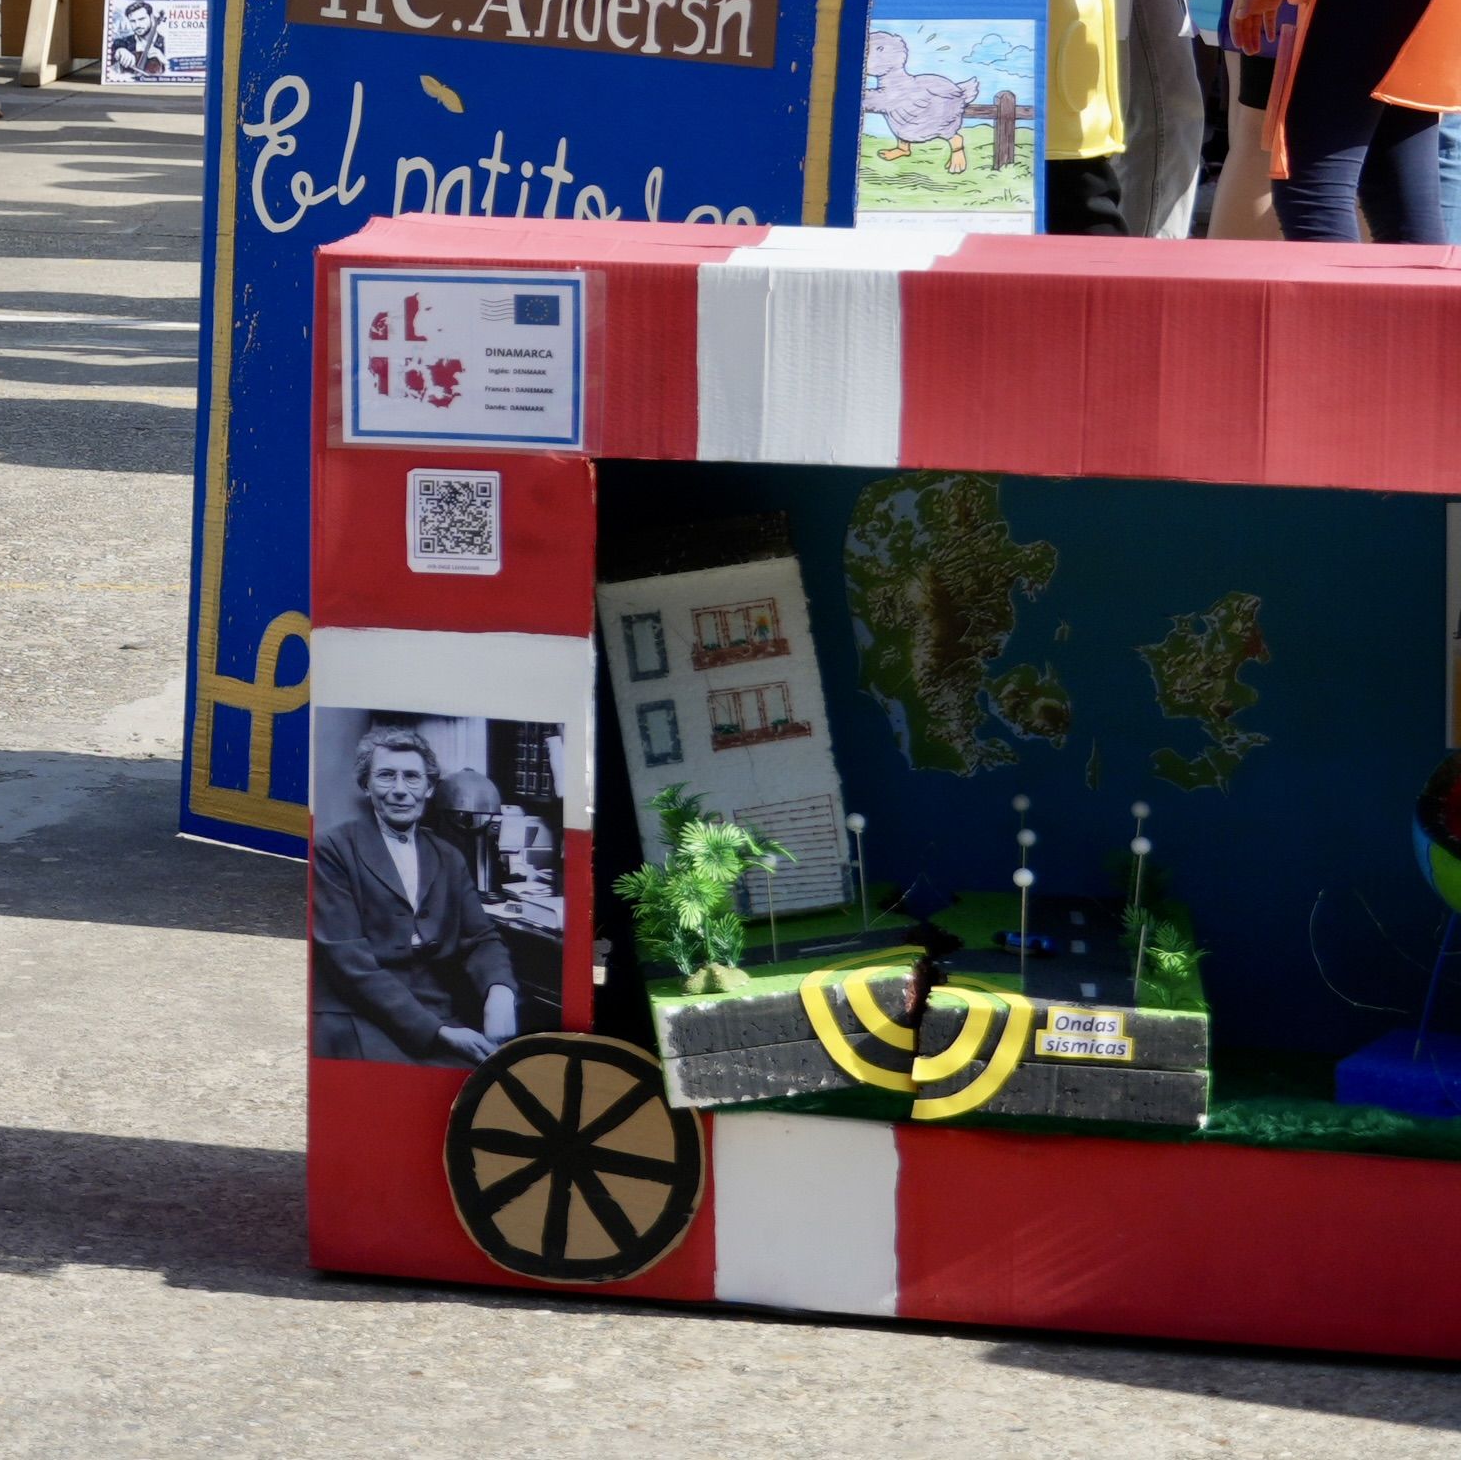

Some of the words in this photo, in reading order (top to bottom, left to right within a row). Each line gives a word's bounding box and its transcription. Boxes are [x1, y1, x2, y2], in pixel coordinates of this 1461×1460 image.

[168, 21, 179, 29] ES
[181, 20, 206, 29] CROA
[242, 75, 366, 234] El
[485, 347, 554, 359] DINAMARCA
[509, 404, 545, 412] DANMARK
[1055, 1015, 1118, 1033] Ondas
